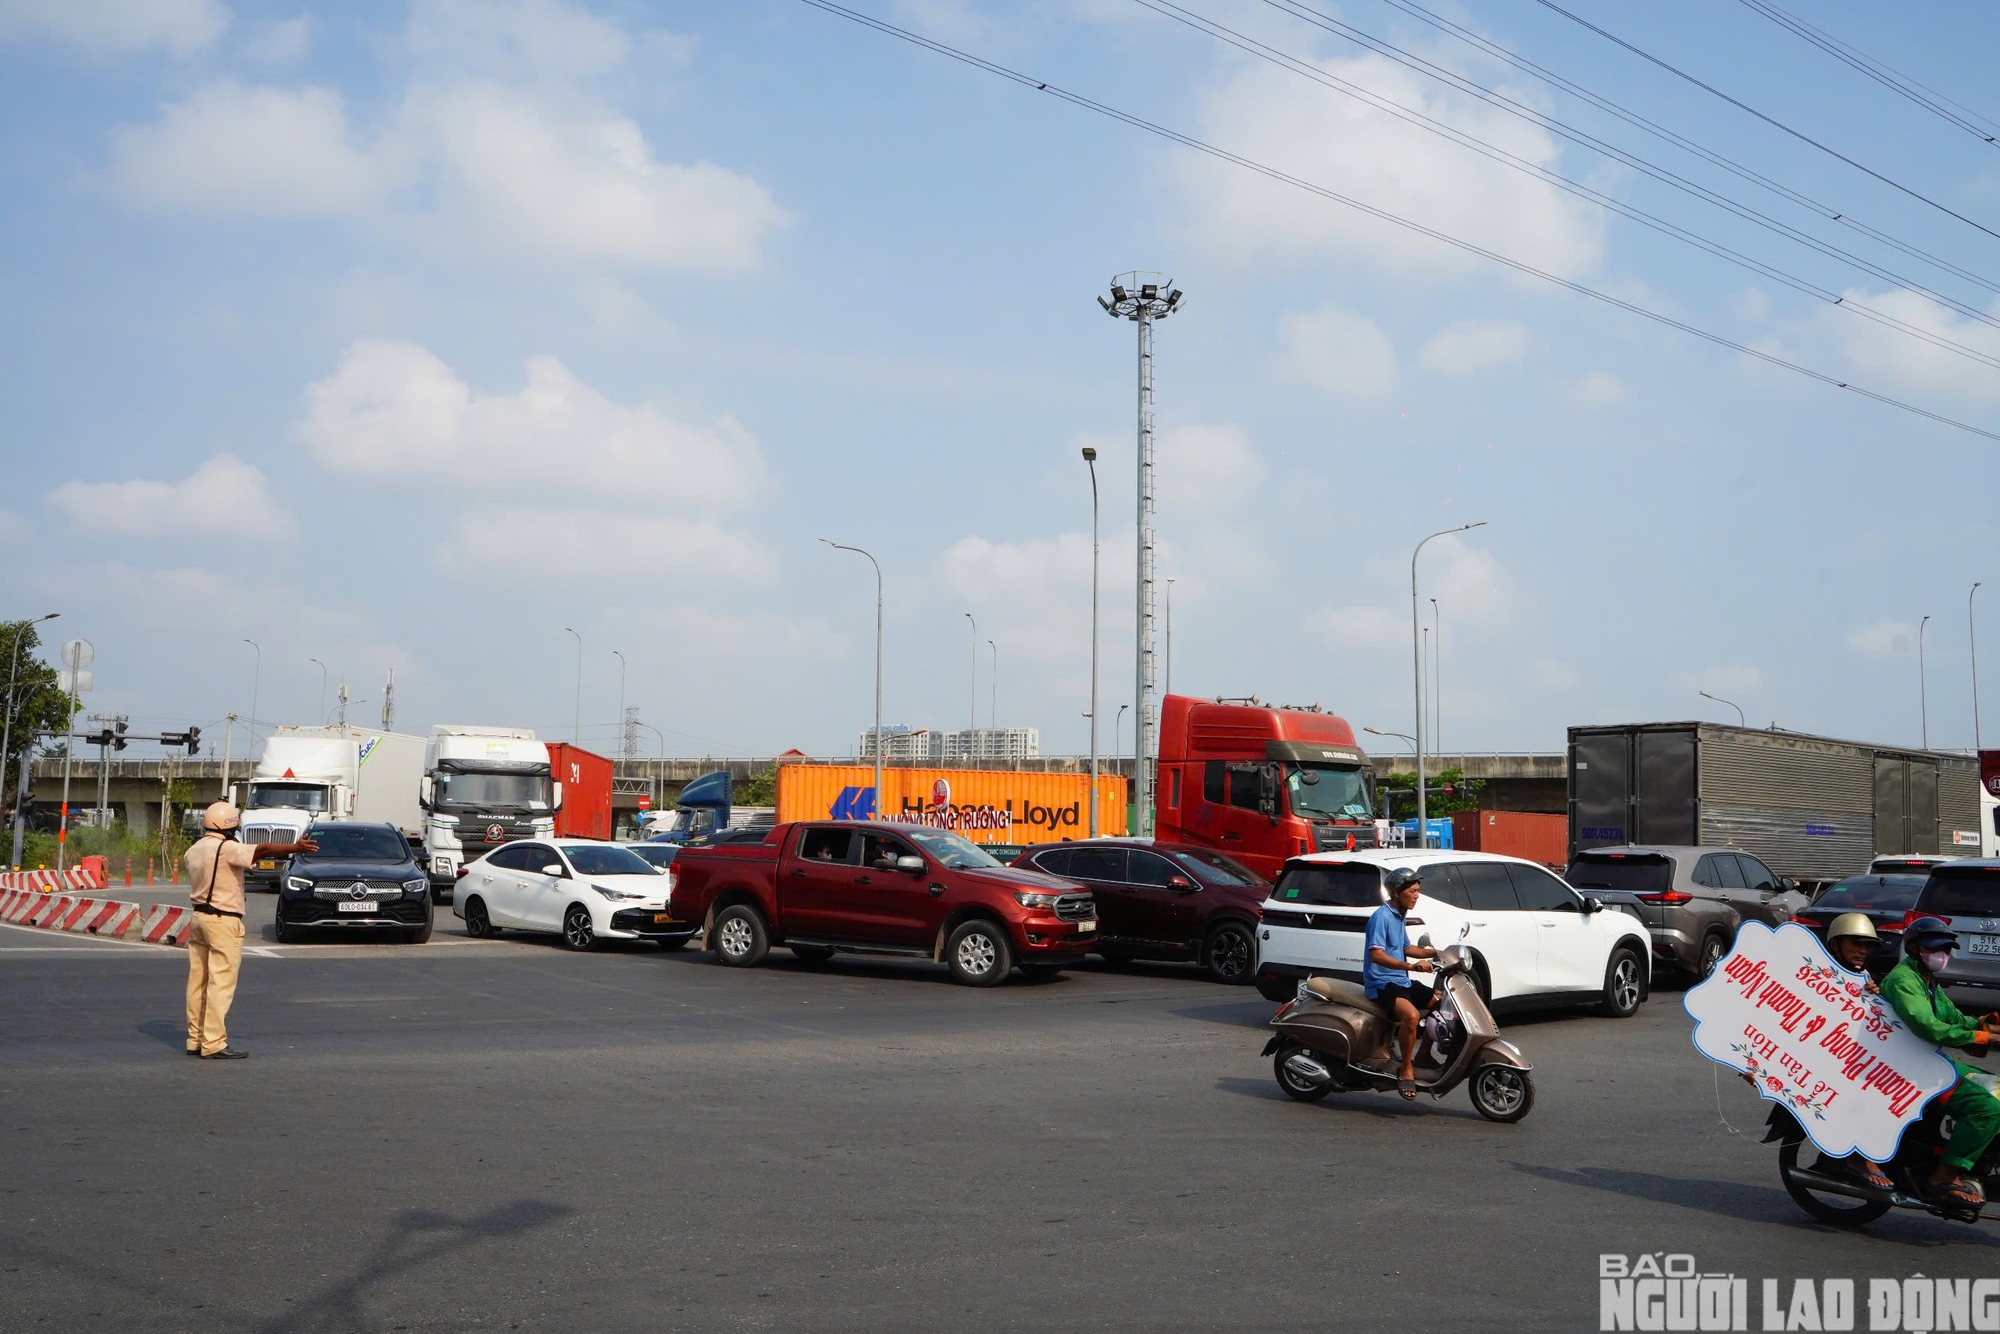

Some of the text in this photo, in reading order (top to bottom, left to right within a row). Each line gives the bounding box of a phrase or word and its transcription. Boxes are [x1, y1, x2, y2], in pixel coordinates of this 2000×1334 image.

[958, 806, 1007, 830] TRƯỜNG
[1980, 936, 1997, 945] 51K
[1724, 953, 1923, 1119] Thanh Phong & Thanh Ngân
[1795, 965, 1895, 1042] 26-04-2026
[1743, 1024, 1839, 1108] Lễ Tân Hôn
